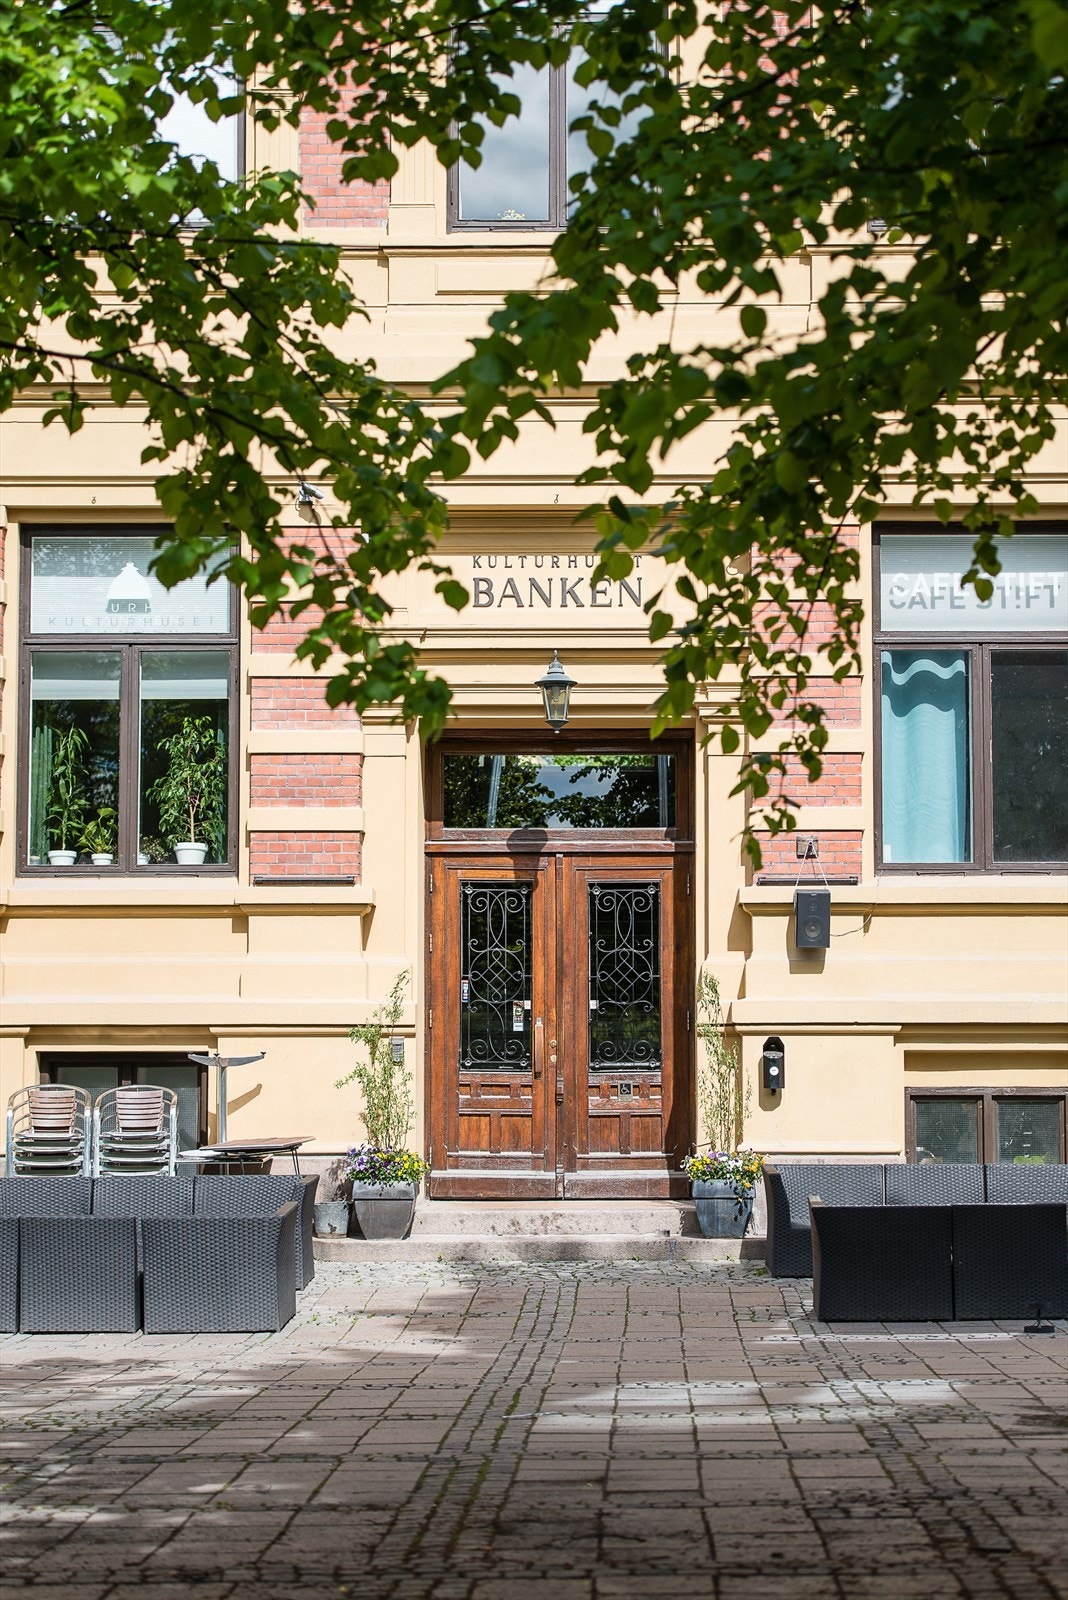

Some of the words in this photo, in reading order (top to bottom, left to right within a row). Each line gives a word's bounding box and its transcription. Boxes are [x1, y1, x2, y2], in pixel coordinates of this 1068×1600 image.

[472, 555, 643, 569] KULTURHUT
[472, 577, 643, 608] BANKEN
[48, 617, 214, 627] KULTURHUSET
